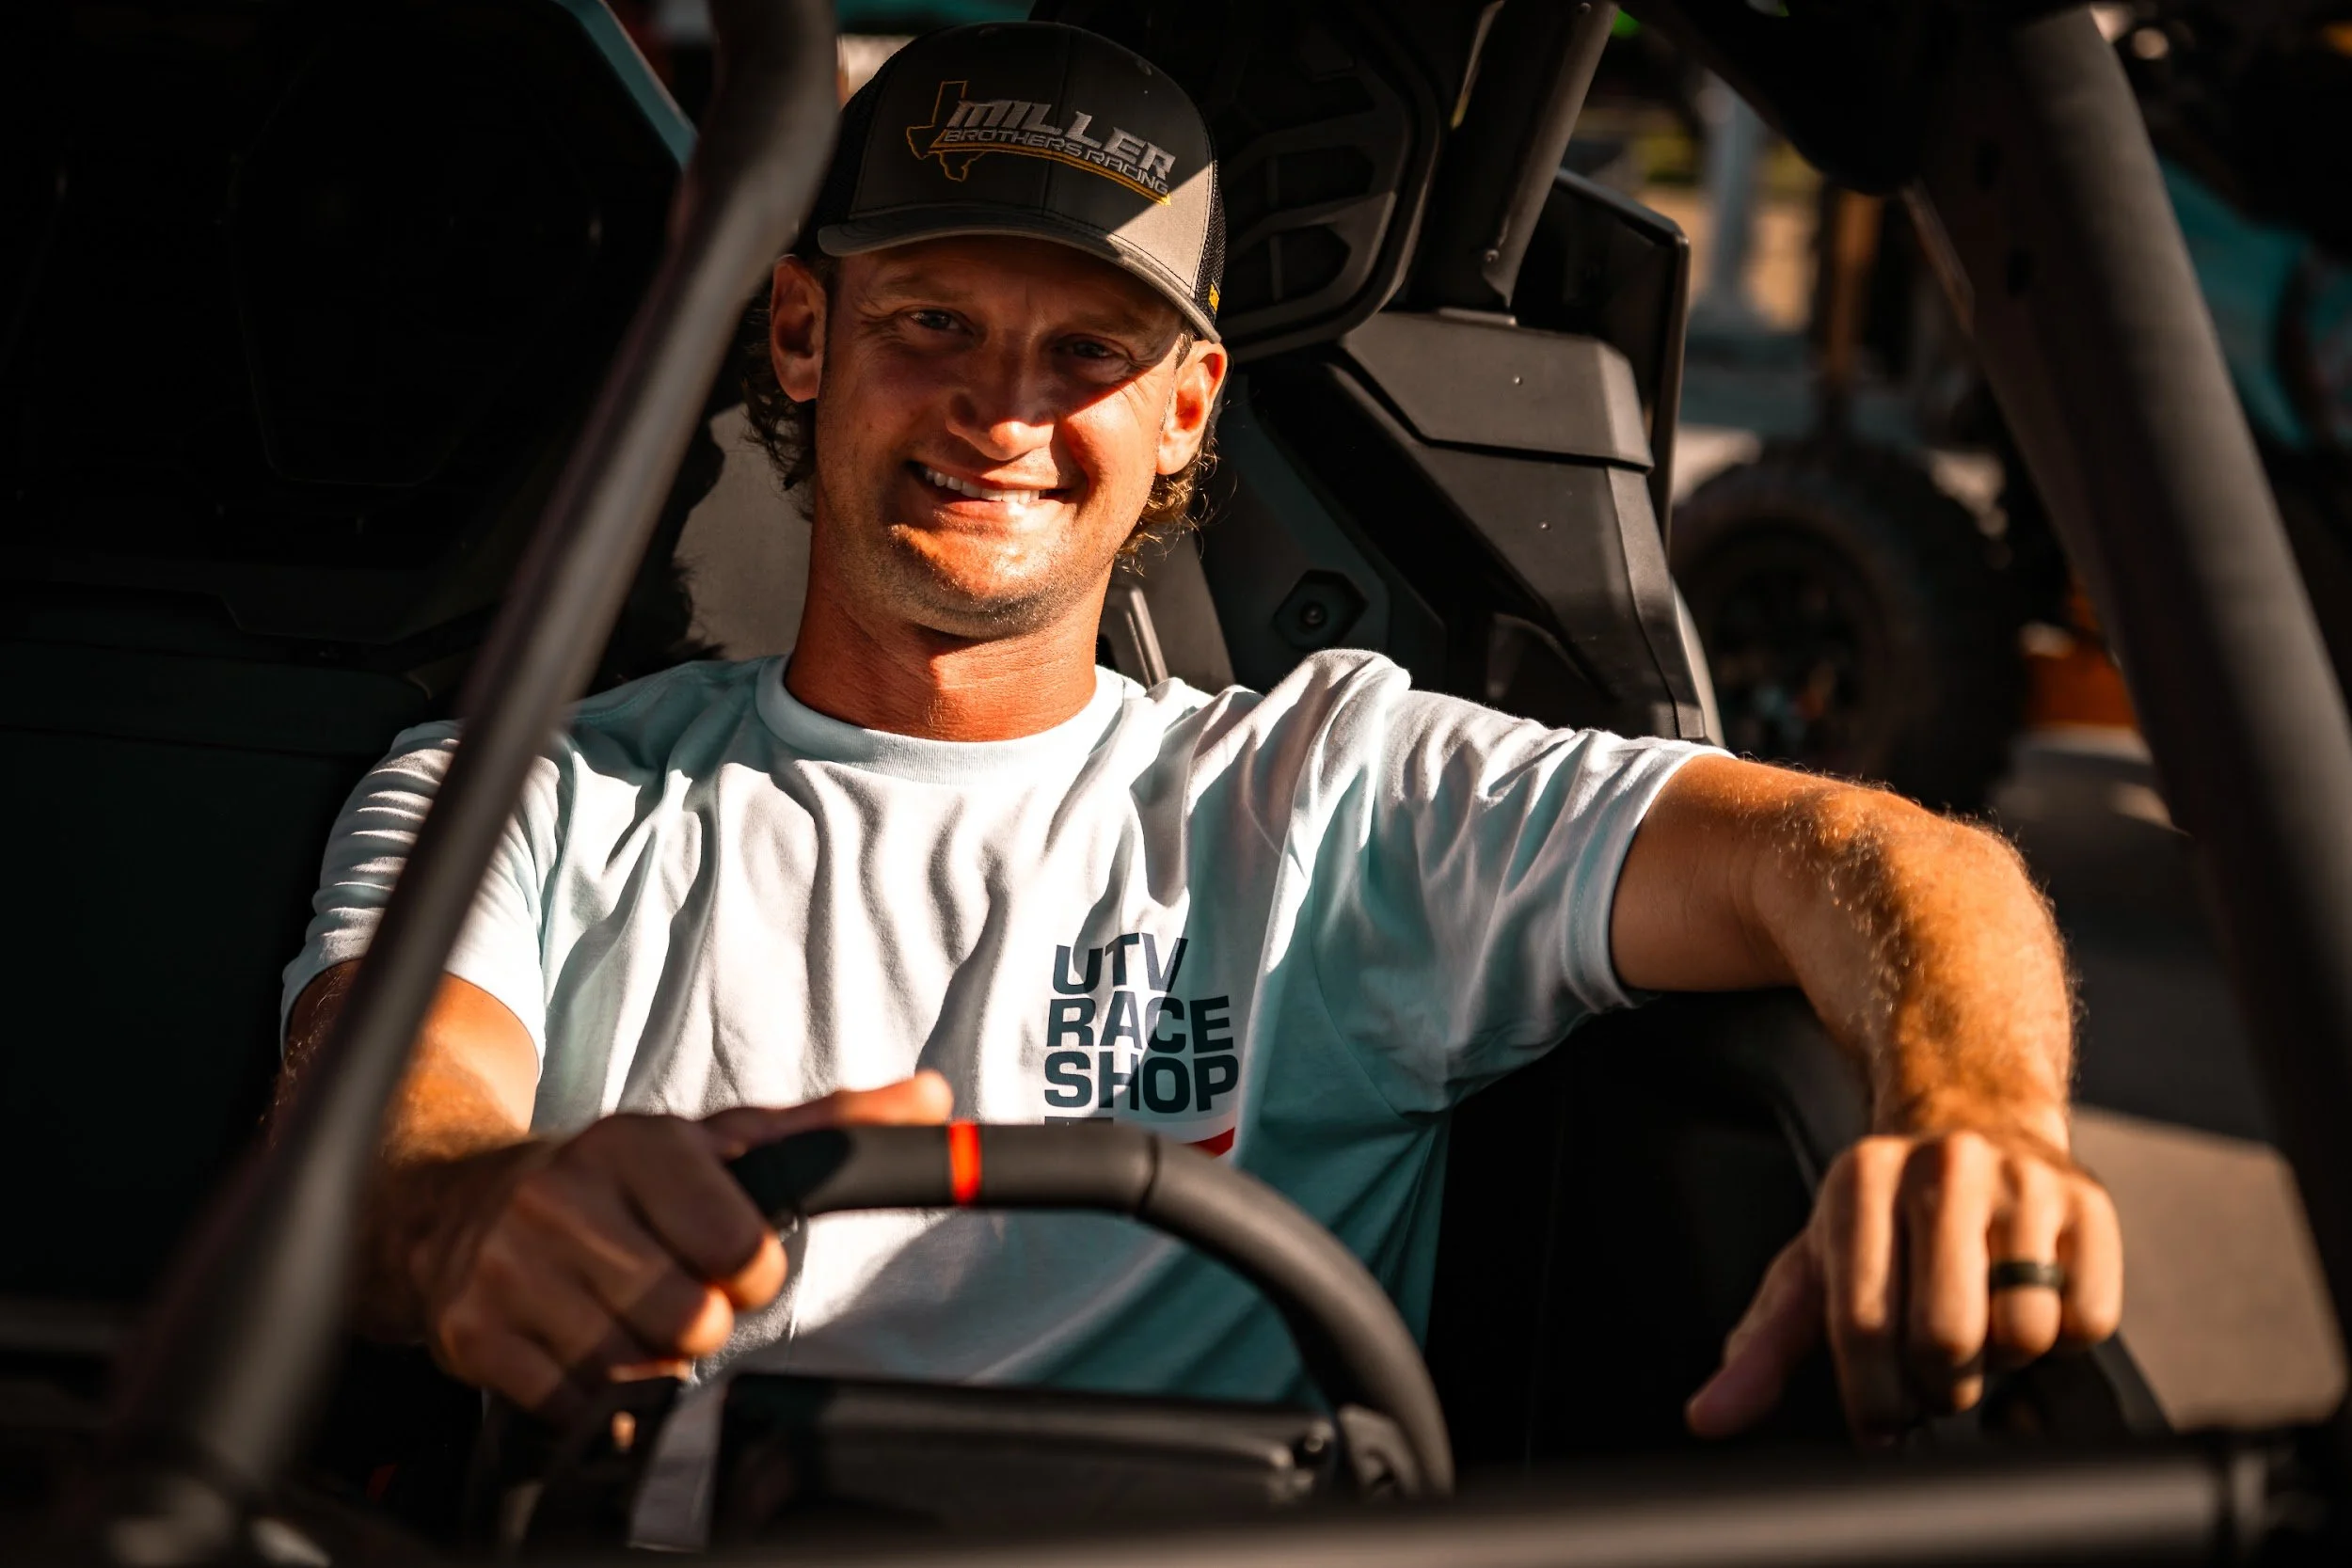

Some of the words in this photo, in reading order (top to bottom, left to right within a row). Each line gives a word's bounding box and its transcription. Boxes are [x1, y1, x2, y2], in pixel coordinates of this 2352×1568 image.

[944, 128, 1083, 158] BROTHERS
[1083, 149, 1170, 195] RACING
[946, 99, 1176, 179] MILLER
[1052, 932, 1189, 995] UTV
[1046, 990, 1234, 1054] RACE
[1044, 1051, 1239, 1114] SHOP
